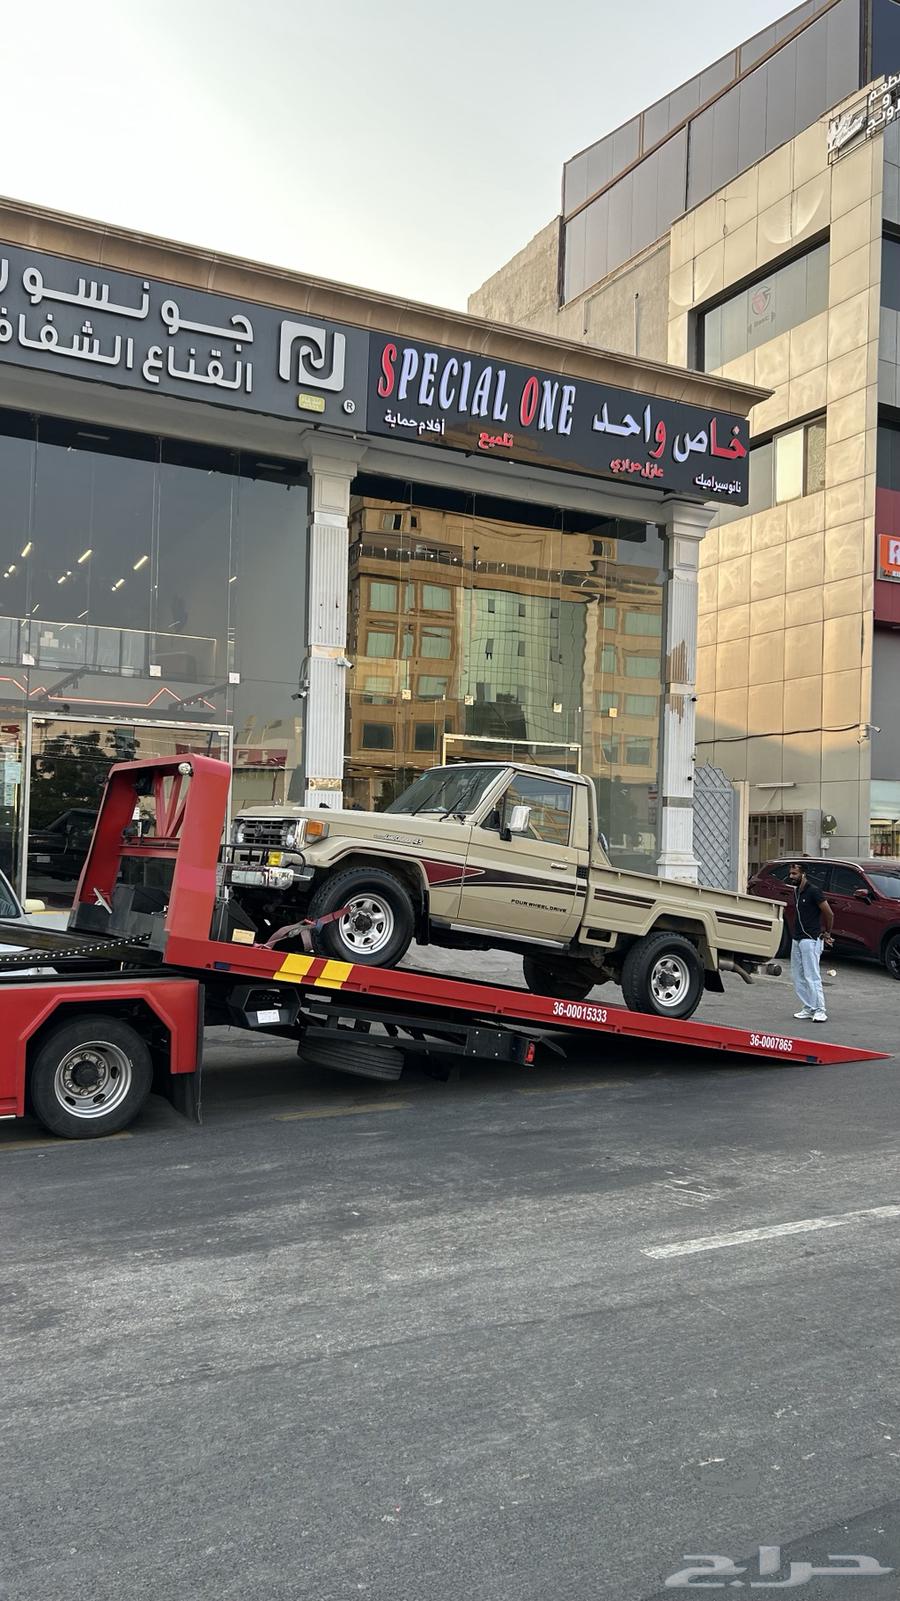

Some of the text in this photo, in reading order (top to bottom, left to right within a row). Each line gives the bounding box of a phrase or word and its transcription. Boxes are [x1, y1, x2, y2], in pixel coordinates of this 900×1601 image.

[143, 345, 253, 392] القناع
[377, 343, 577, 436] SPECIAL ONE
[384, 408, 446, 435] أفلام حماية
[592, 402, 747, 463] خاص واحد
[478, 432, 514, 449] تلميع
[610, 458, 665, 480] عازل حراري
[529, 902, 549, 910] WHEEL
[552, 1001, 608, 1024] 36-00015333
[750, 1033, 793, 1052] 36-0007865
